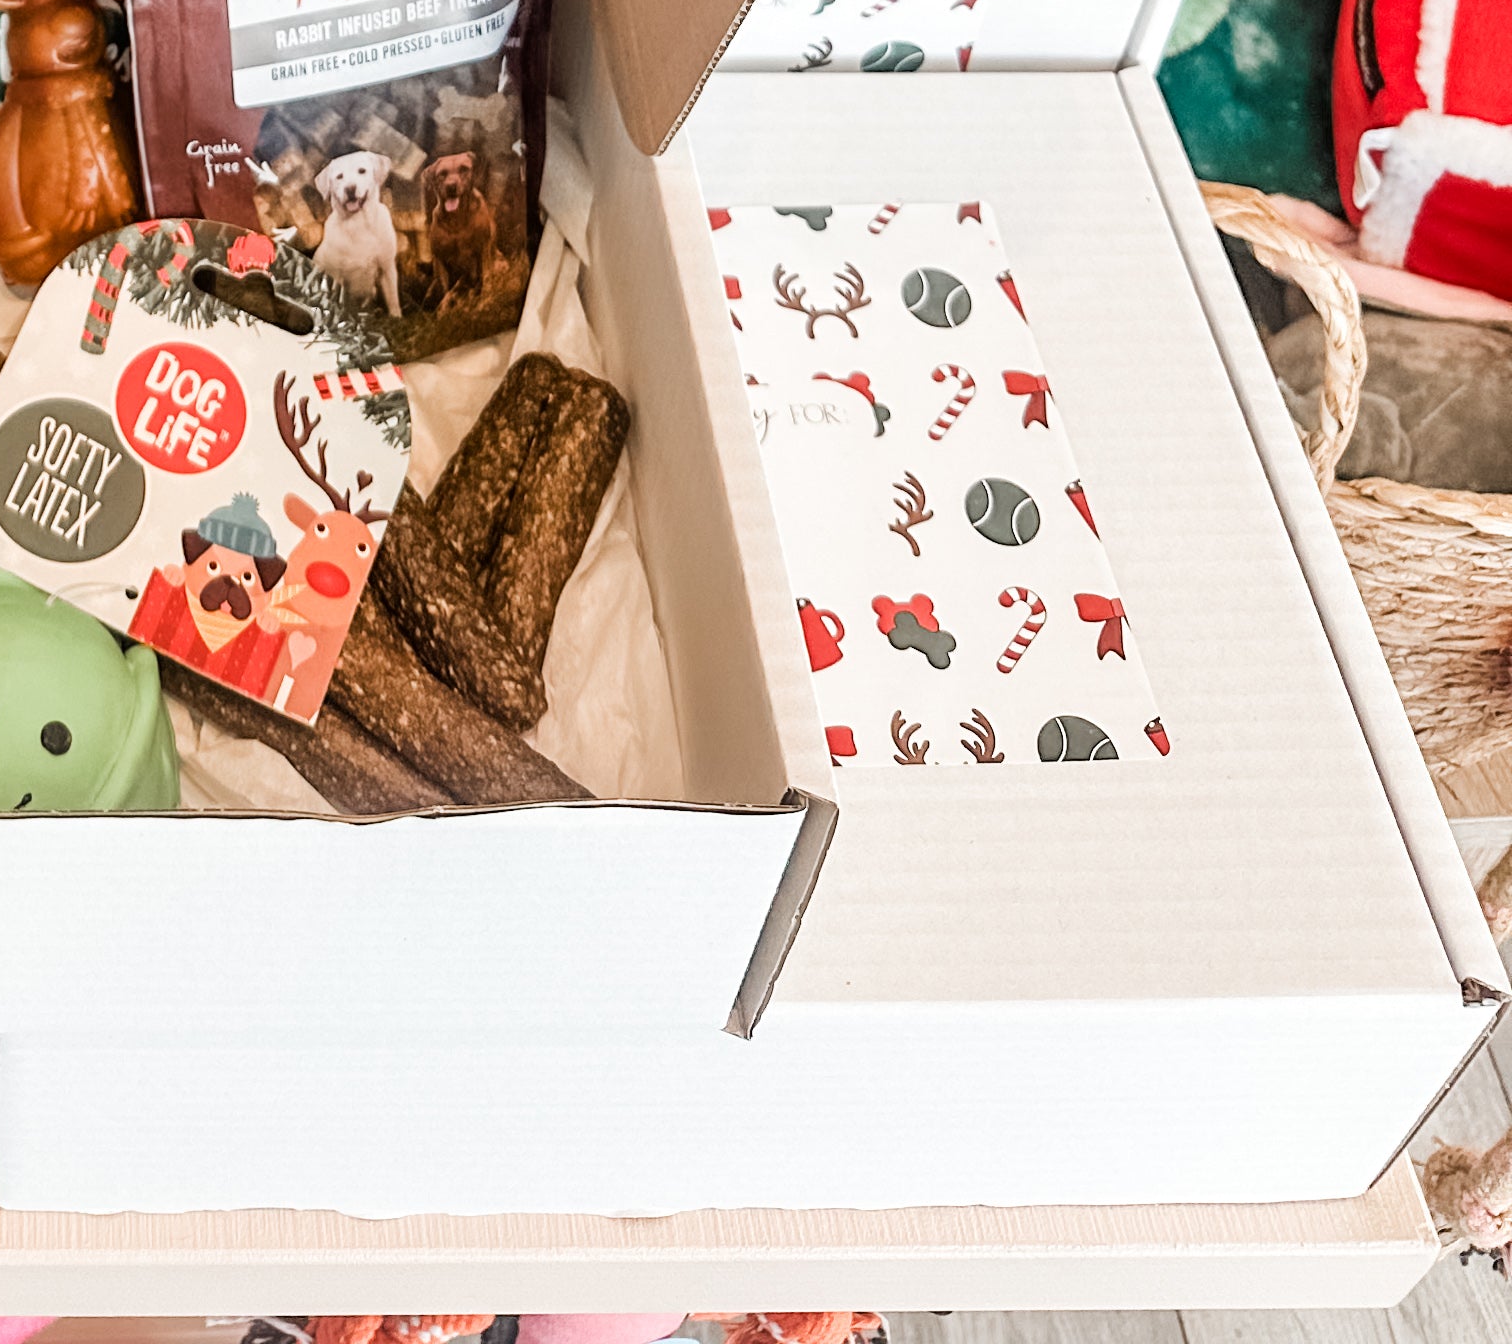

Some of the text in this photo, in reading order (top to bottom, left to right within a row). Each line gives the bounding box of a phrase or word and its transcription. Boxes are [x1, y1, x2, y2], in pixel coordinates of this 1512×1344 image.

[271, 12, 506, 81] GRAIN FREE COLD PRESSED GLUTEN FREE
[275, 19, 333, 50] RABBIT
[338, 7, 402, 36] INFUSED
[186, 138, 242, 158] Grain
[204, 152, 242, 189] free
[144, 350, 228, 418] DOG
[25, 414, 123, 496] SOFTY
[4, 461, 102, 550] LATEX
